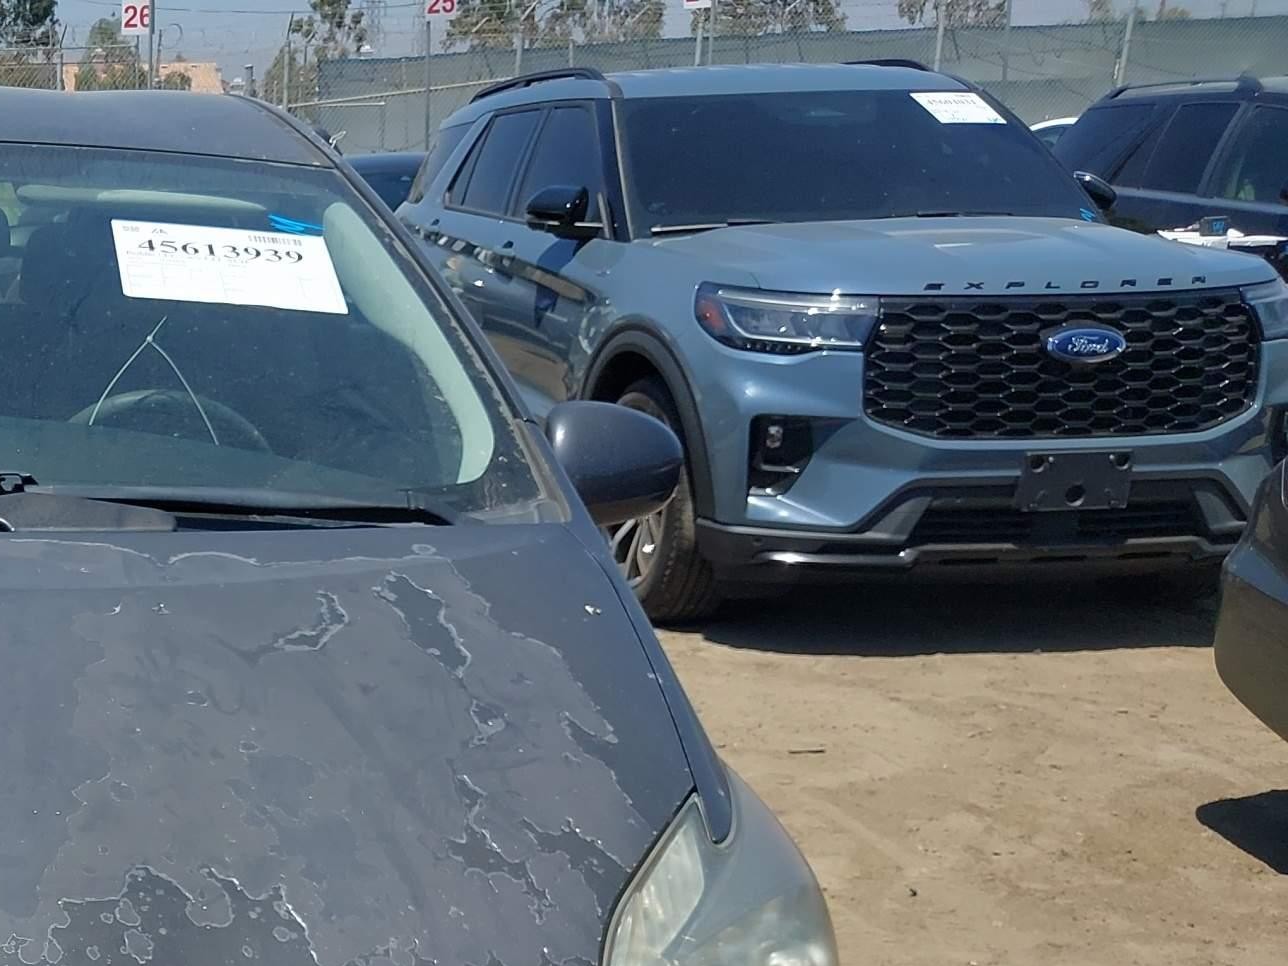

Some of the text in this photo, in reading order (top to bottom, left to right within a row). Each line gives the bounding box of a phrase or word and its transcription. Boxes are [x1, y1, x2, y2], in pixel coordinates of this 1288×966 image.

[427, 0, 454, 14] 25
[123, 5, 149, 28] 26
[138, 239, 304, 264] 45613939
[923, 275, 1207, 291] EXPLORER
[1068, 335, 1109, 353] Ford
